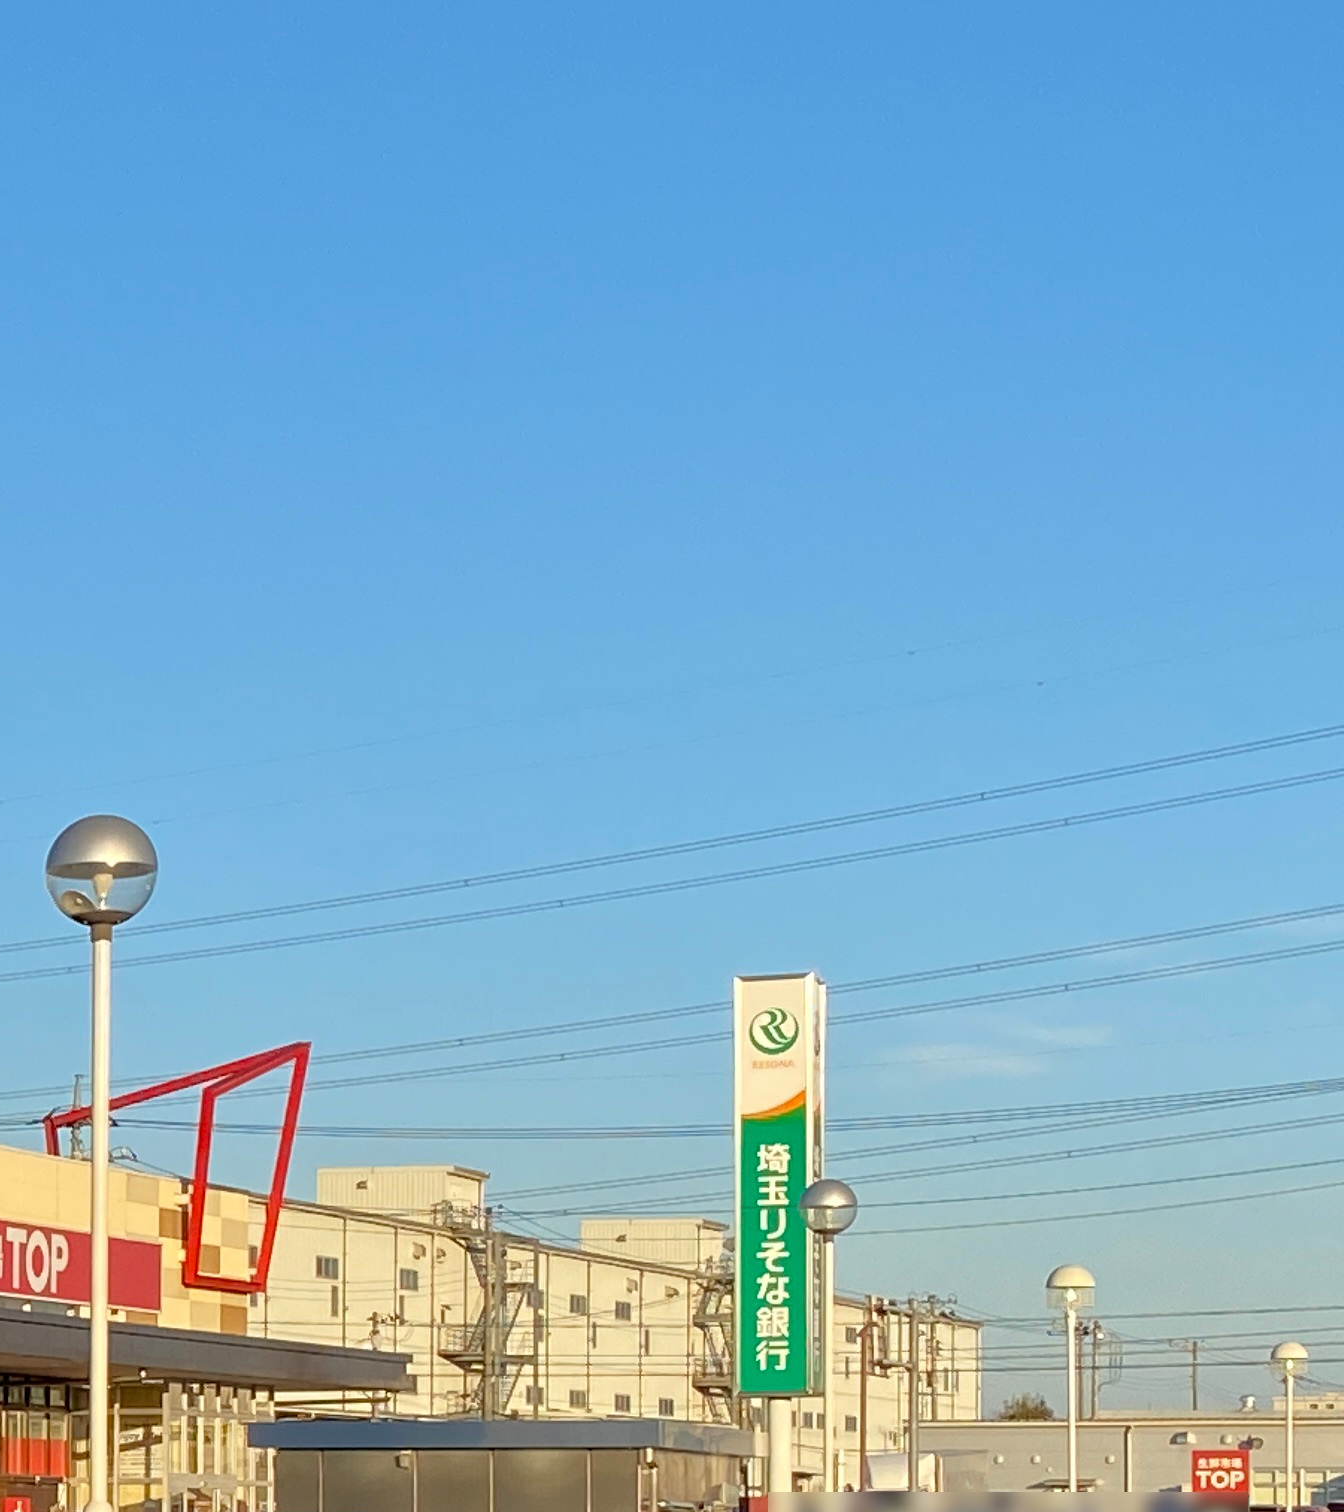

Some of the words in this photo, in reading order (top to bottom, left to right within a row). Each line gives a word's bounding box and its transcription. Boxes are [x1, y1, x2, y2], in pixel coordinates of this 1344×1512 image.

[6, 1226, 69, 1294] TOP
[756, 1143, 791, 1372] 埼玉りそな銀行
[1195, 1470, 1245, 1489] TOP
